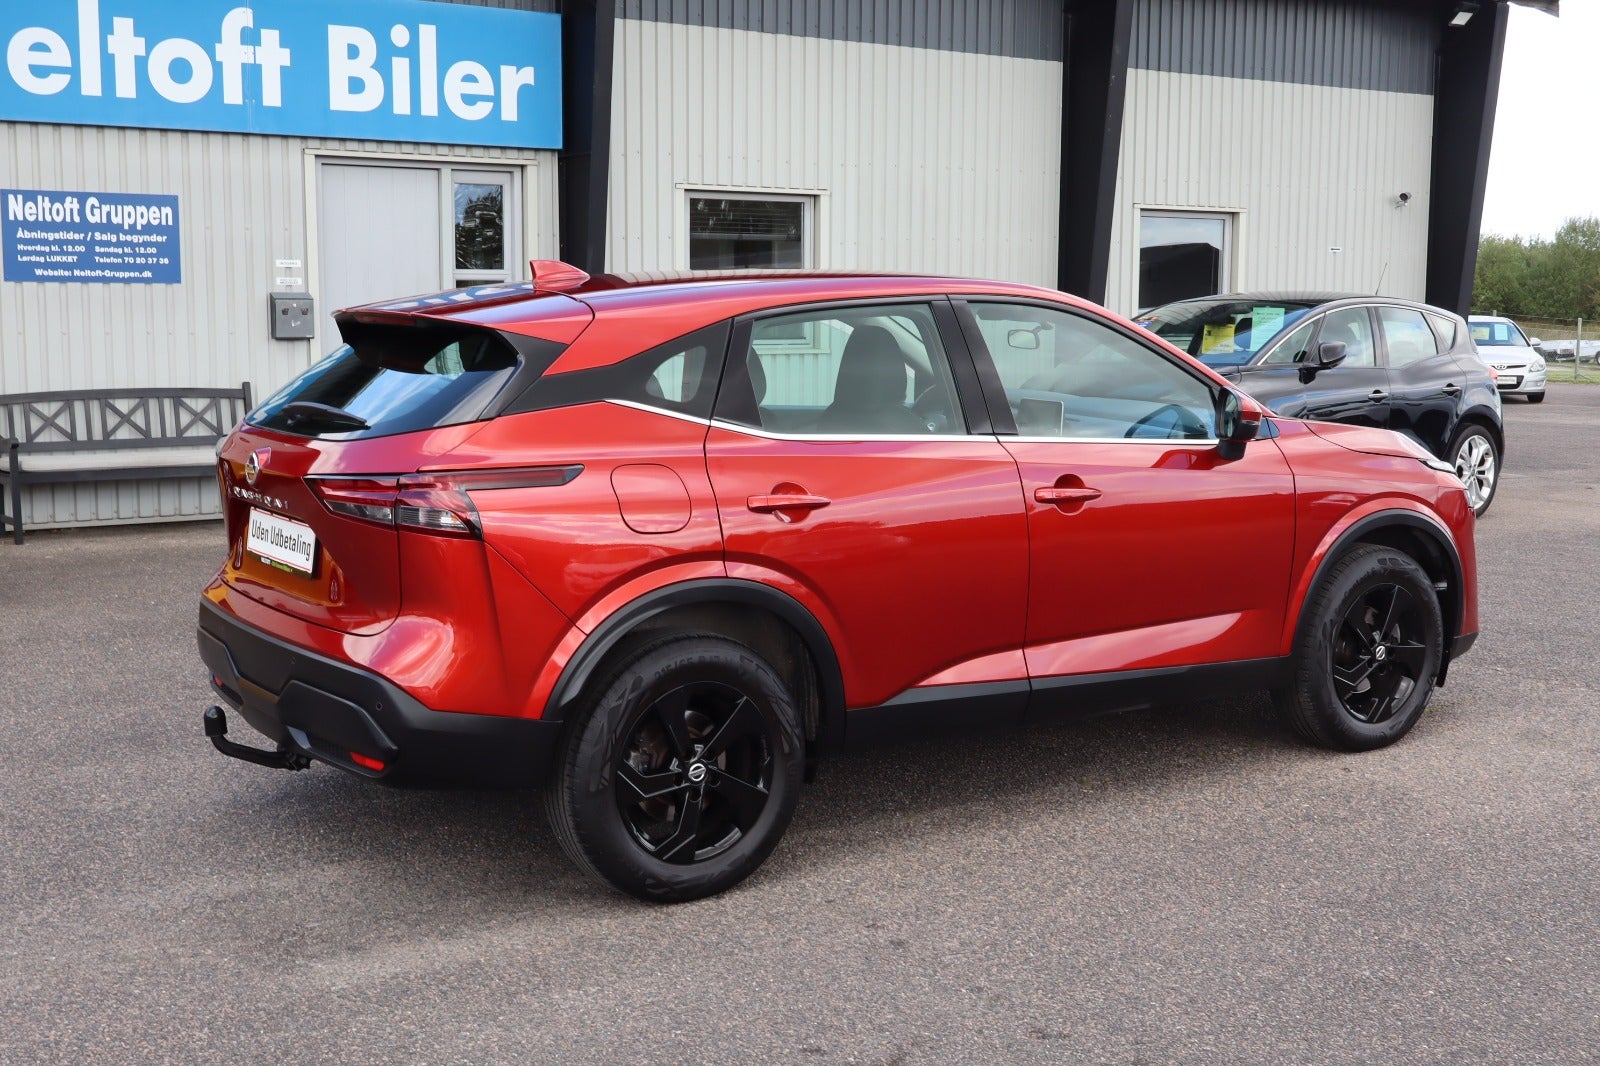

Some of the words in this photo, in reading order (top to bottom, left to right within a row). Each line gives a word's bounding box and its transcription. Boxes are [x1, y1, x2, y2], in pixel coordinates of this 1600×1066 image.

[6, 0, 291, 107] eltoft
[327, 24, 535, 122] Biler
[8, 194, 80, 222] Neltoft
[86, 197, 173, 229] Gruppen
[17, 228, 84, 240] Åbningstider
[86, 231, 92, 242] /
[94, 231, 117, 242] Salg
[119, 232, 168, 243] begynder
[17, 244, 50, 252] Hverdag
[62, 245, 86, 253] 12.00
[95, 245, 122, 254] Søndag
[17, 254, 45, 263] Lørdag
[46, 255, 78, 263] LUKKET
[95, 256, 122, 264] Telefon
[35, 268, 72, 277] Website:
[74, 269, 152, 278] Neltoft-Gruppen.dk
[251, 519, 269, 542] Uden
[270, 525, 311, 561] Udbetaling
